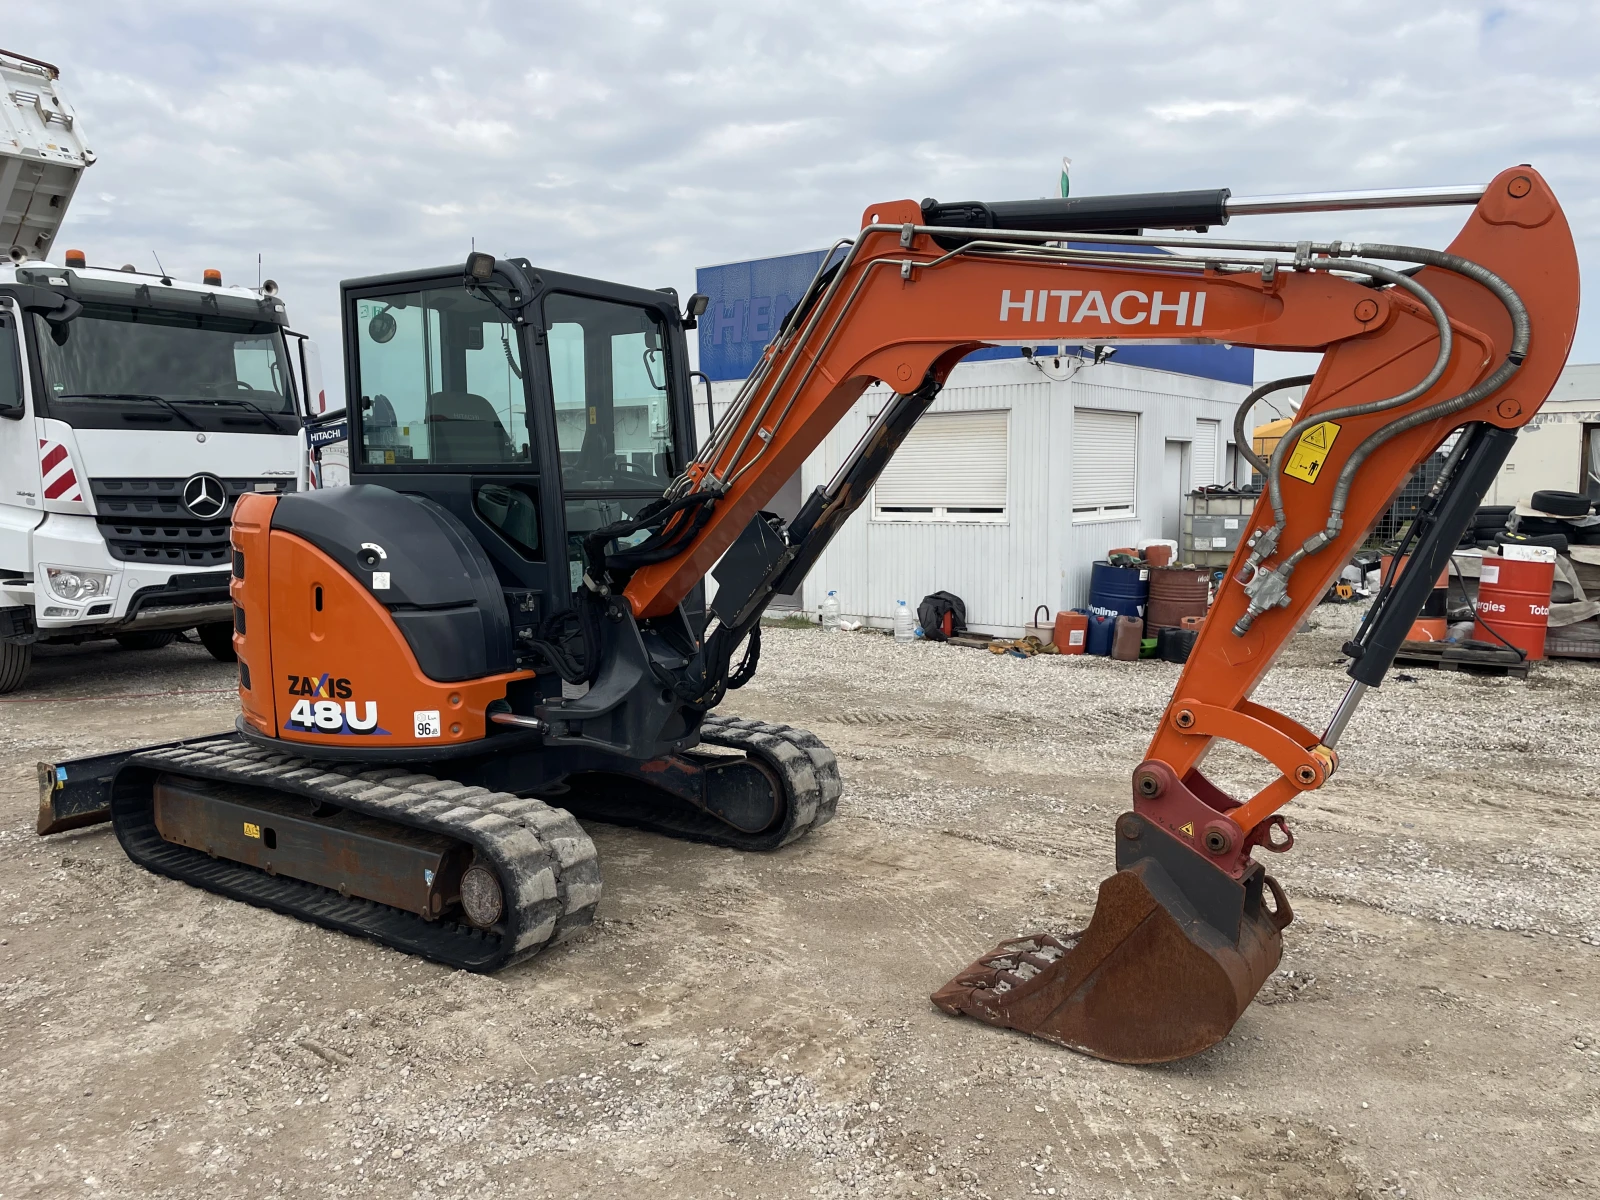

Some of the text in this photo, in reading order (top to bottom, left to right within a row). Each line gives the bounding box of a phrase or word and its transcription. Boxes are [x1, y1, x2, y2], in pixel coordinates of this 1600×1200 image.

[999, 289, 1207, 327] HITACHI
[310, 429, 341, 441] HITACHI
[287, 673, 353, 699] ZAXIS
[290, 698, 378, 735] 48U
[417, 722, 431, 736] 96
